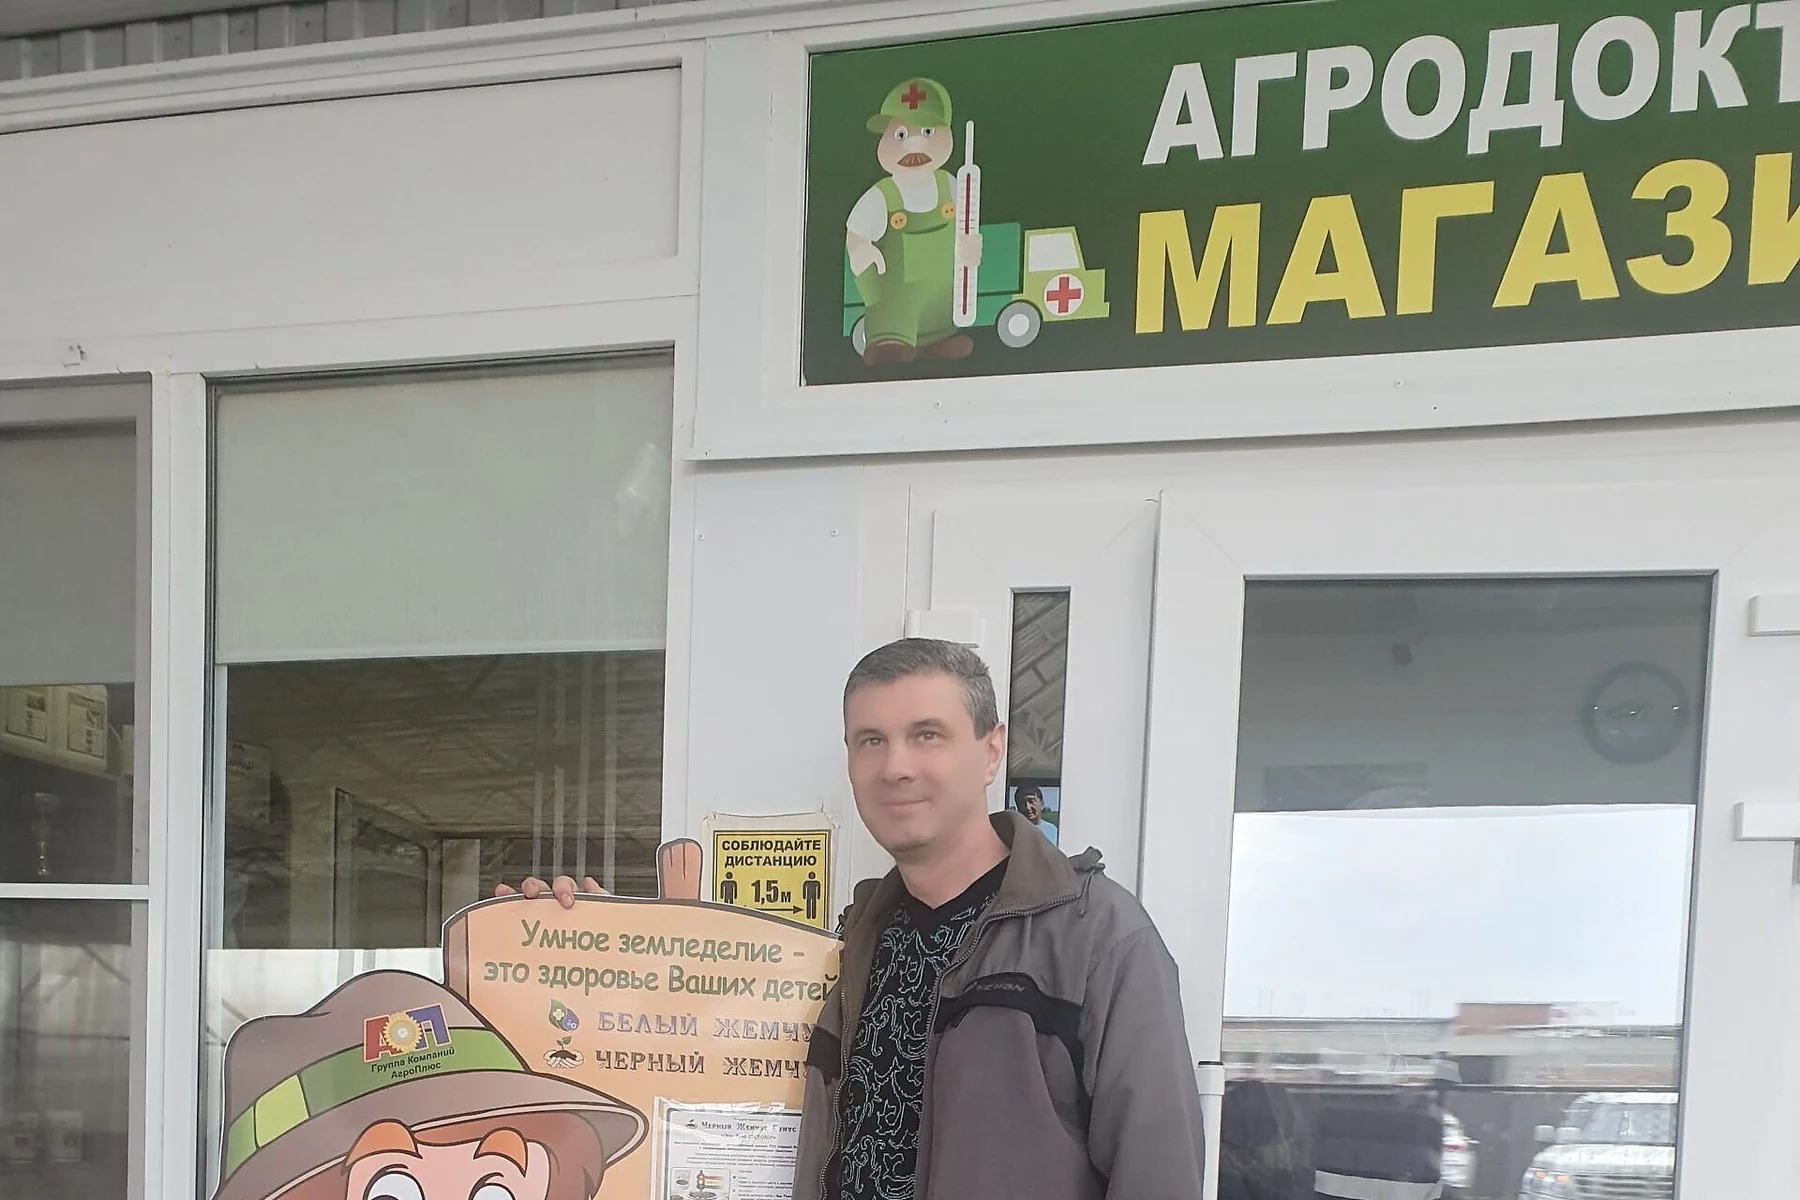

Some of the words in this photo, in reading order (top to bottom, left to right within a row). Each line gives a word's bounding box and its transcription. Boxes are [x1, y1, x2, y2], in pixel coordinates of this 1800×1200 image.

[722, 837, 821, 853] СОБЛЮДАЙТЕ
[724, 855, 817, 868] ДИСТАНЦИЮ
[521, 919, 609, 952] Умное
[619, 932, 782, 963] земледелие
[484, 962, 529, 983] это
[538, 964, 658, 995] здоровье
[669, 965, 756, 996] Ваших
[598, 1011, 698, 1036] БЕЛЫЙ
[371, 1060, 405, 1073] Группа
[408, 1047, 455, 1064] Компаний
[391, 1062, 441, 1079] АгроПлюс
[595, 1050, 704, 1074] ЧЕРНЫЙ
